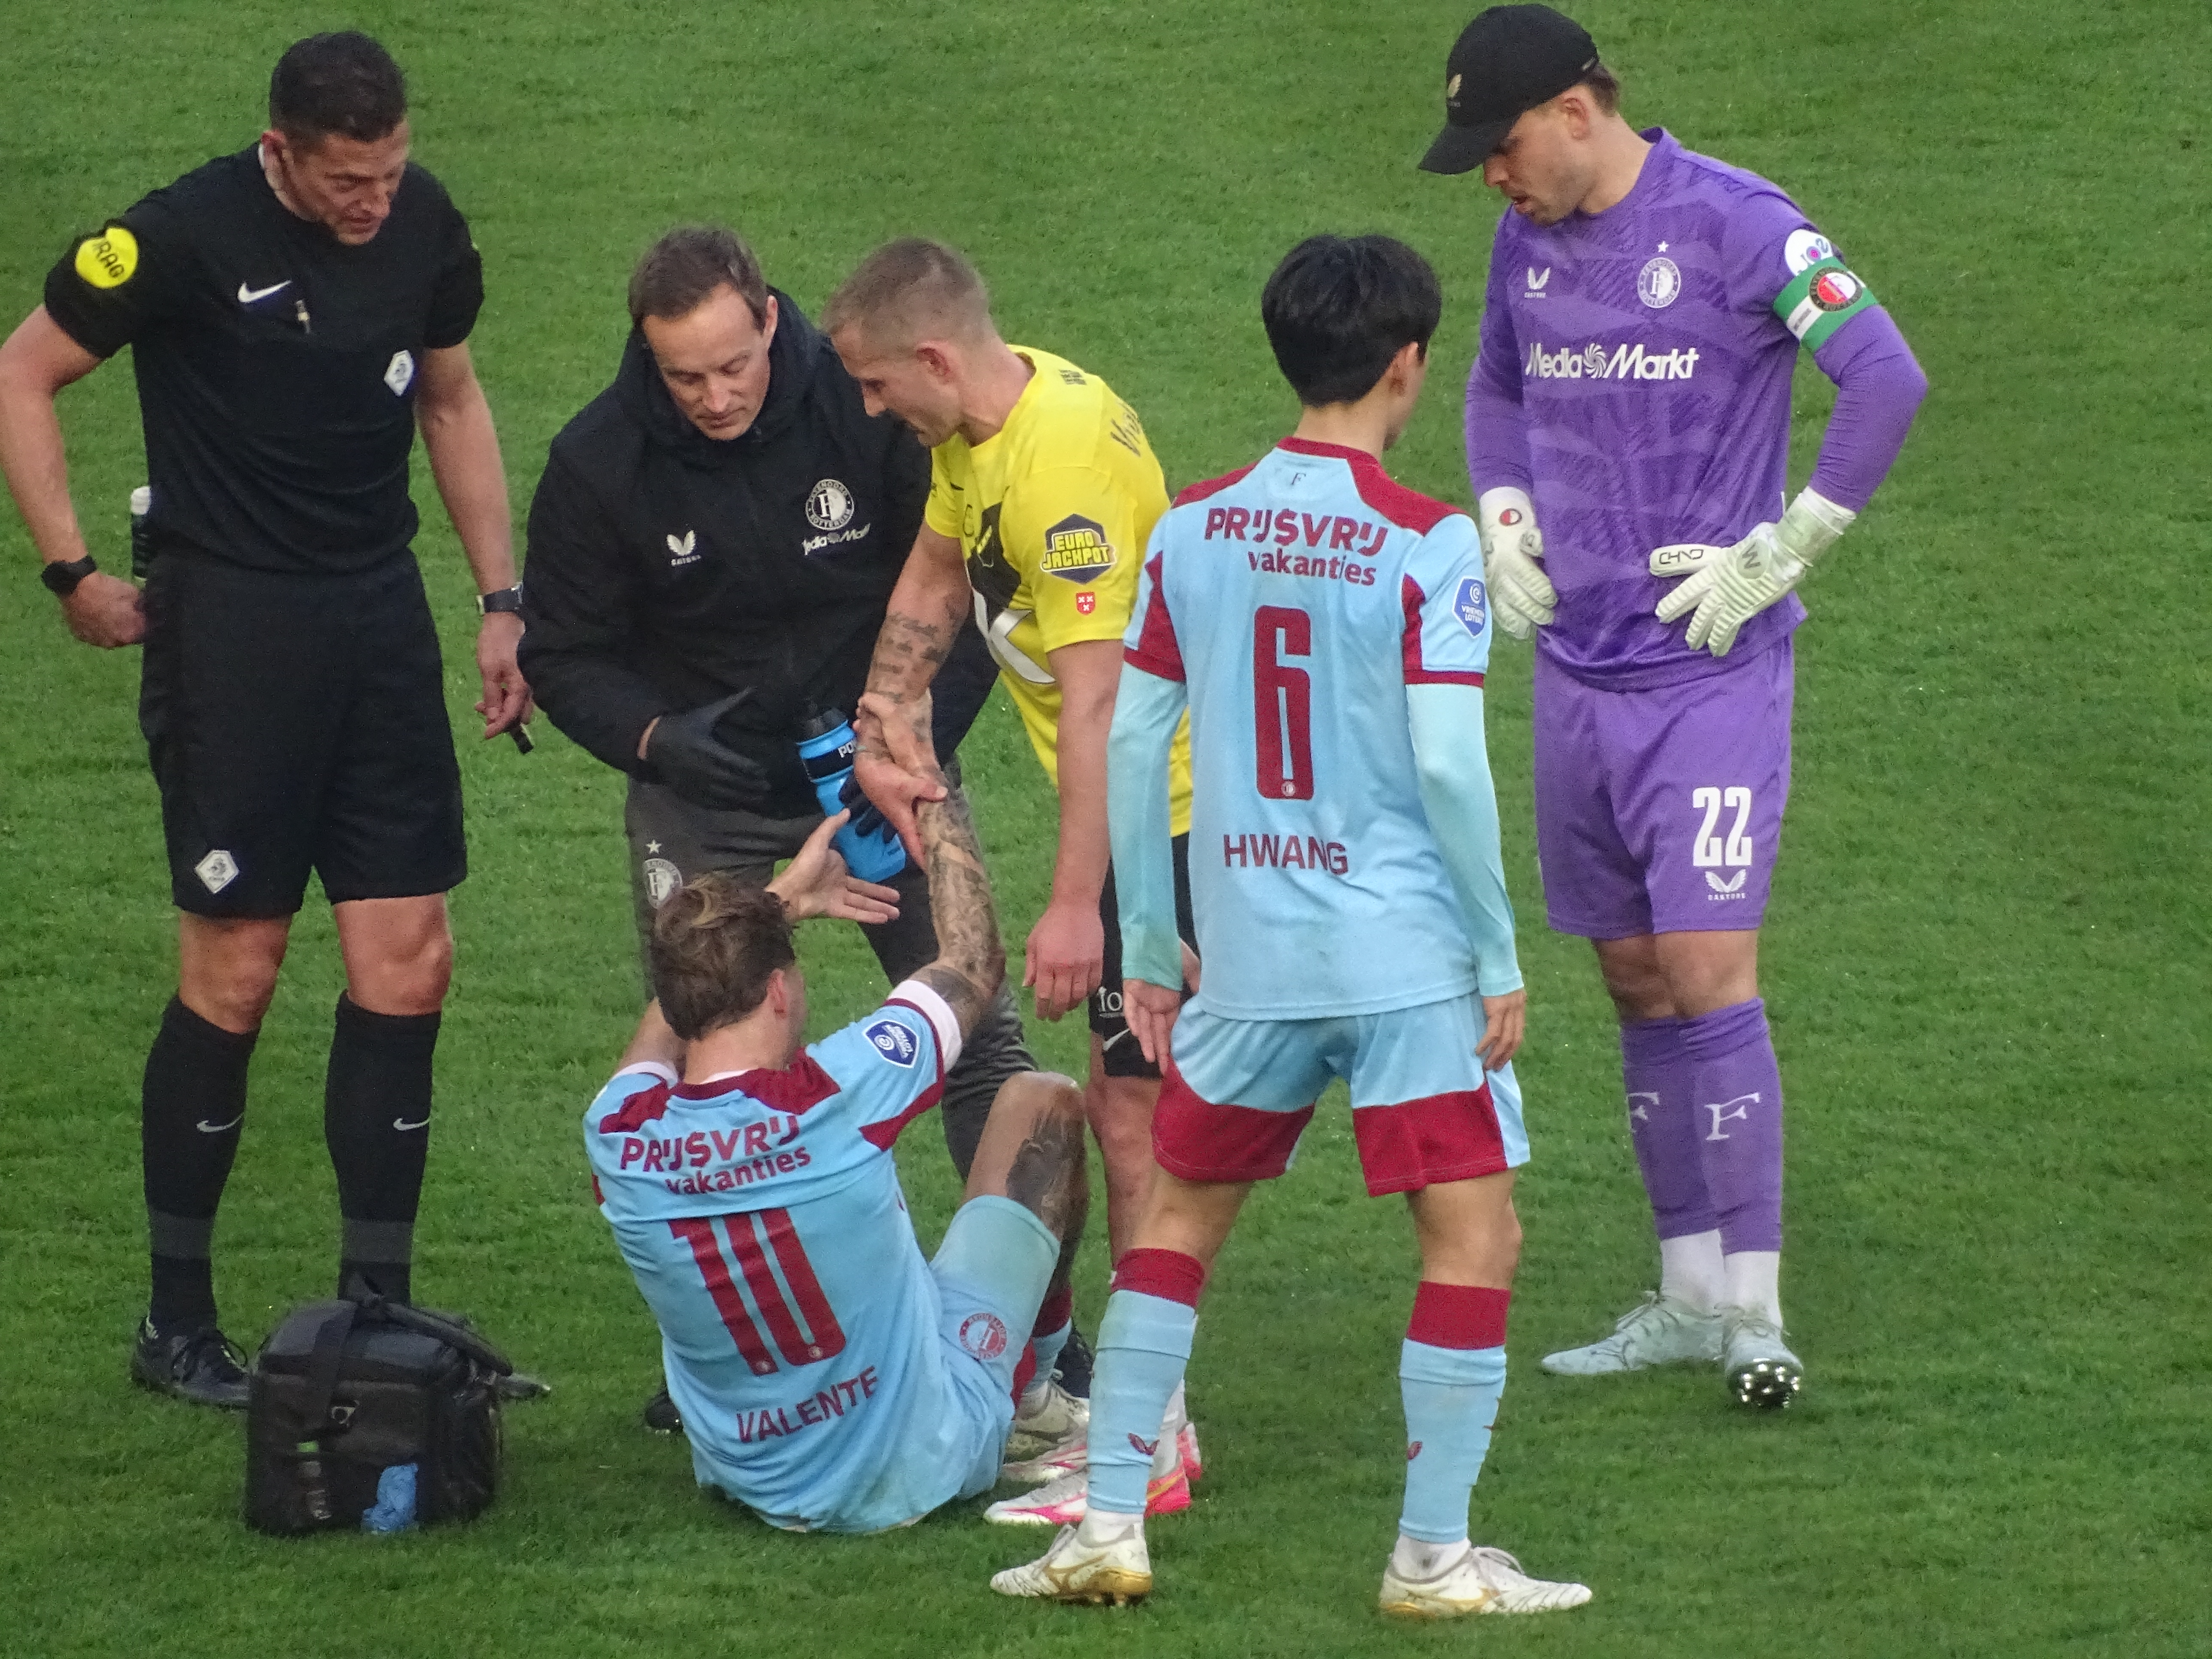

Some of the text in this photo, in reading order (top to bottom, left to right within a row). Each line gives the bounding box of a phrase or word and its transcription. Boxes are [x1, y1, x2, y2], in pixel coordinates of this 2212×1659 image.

[1525, 343, 1700, 379] Media Markt
[1054, 531, 1095, 551] EURO
[1204, 506, 1388, 557] PRIJSVRIJ
[1042, 547, 1109, 570] JACKPOT
[1248, 548, 1377, 585] vakanties
[1254, 605, 1314, 800] 6
[1693, 787, 1752, 867] 22
[1223, 834, 1349, 875] HWANG
[1098, 986, 1123, 1011] 10
[1705, 1092, 1760, 1141] F
[620, 1115, 800, 1172] PRIJSVRIJ
[665, 1146, 811, 1195] vakanties
[668, 1207, 847, 1376] 10
[736, 1366, 877, 1443] VALENTE
